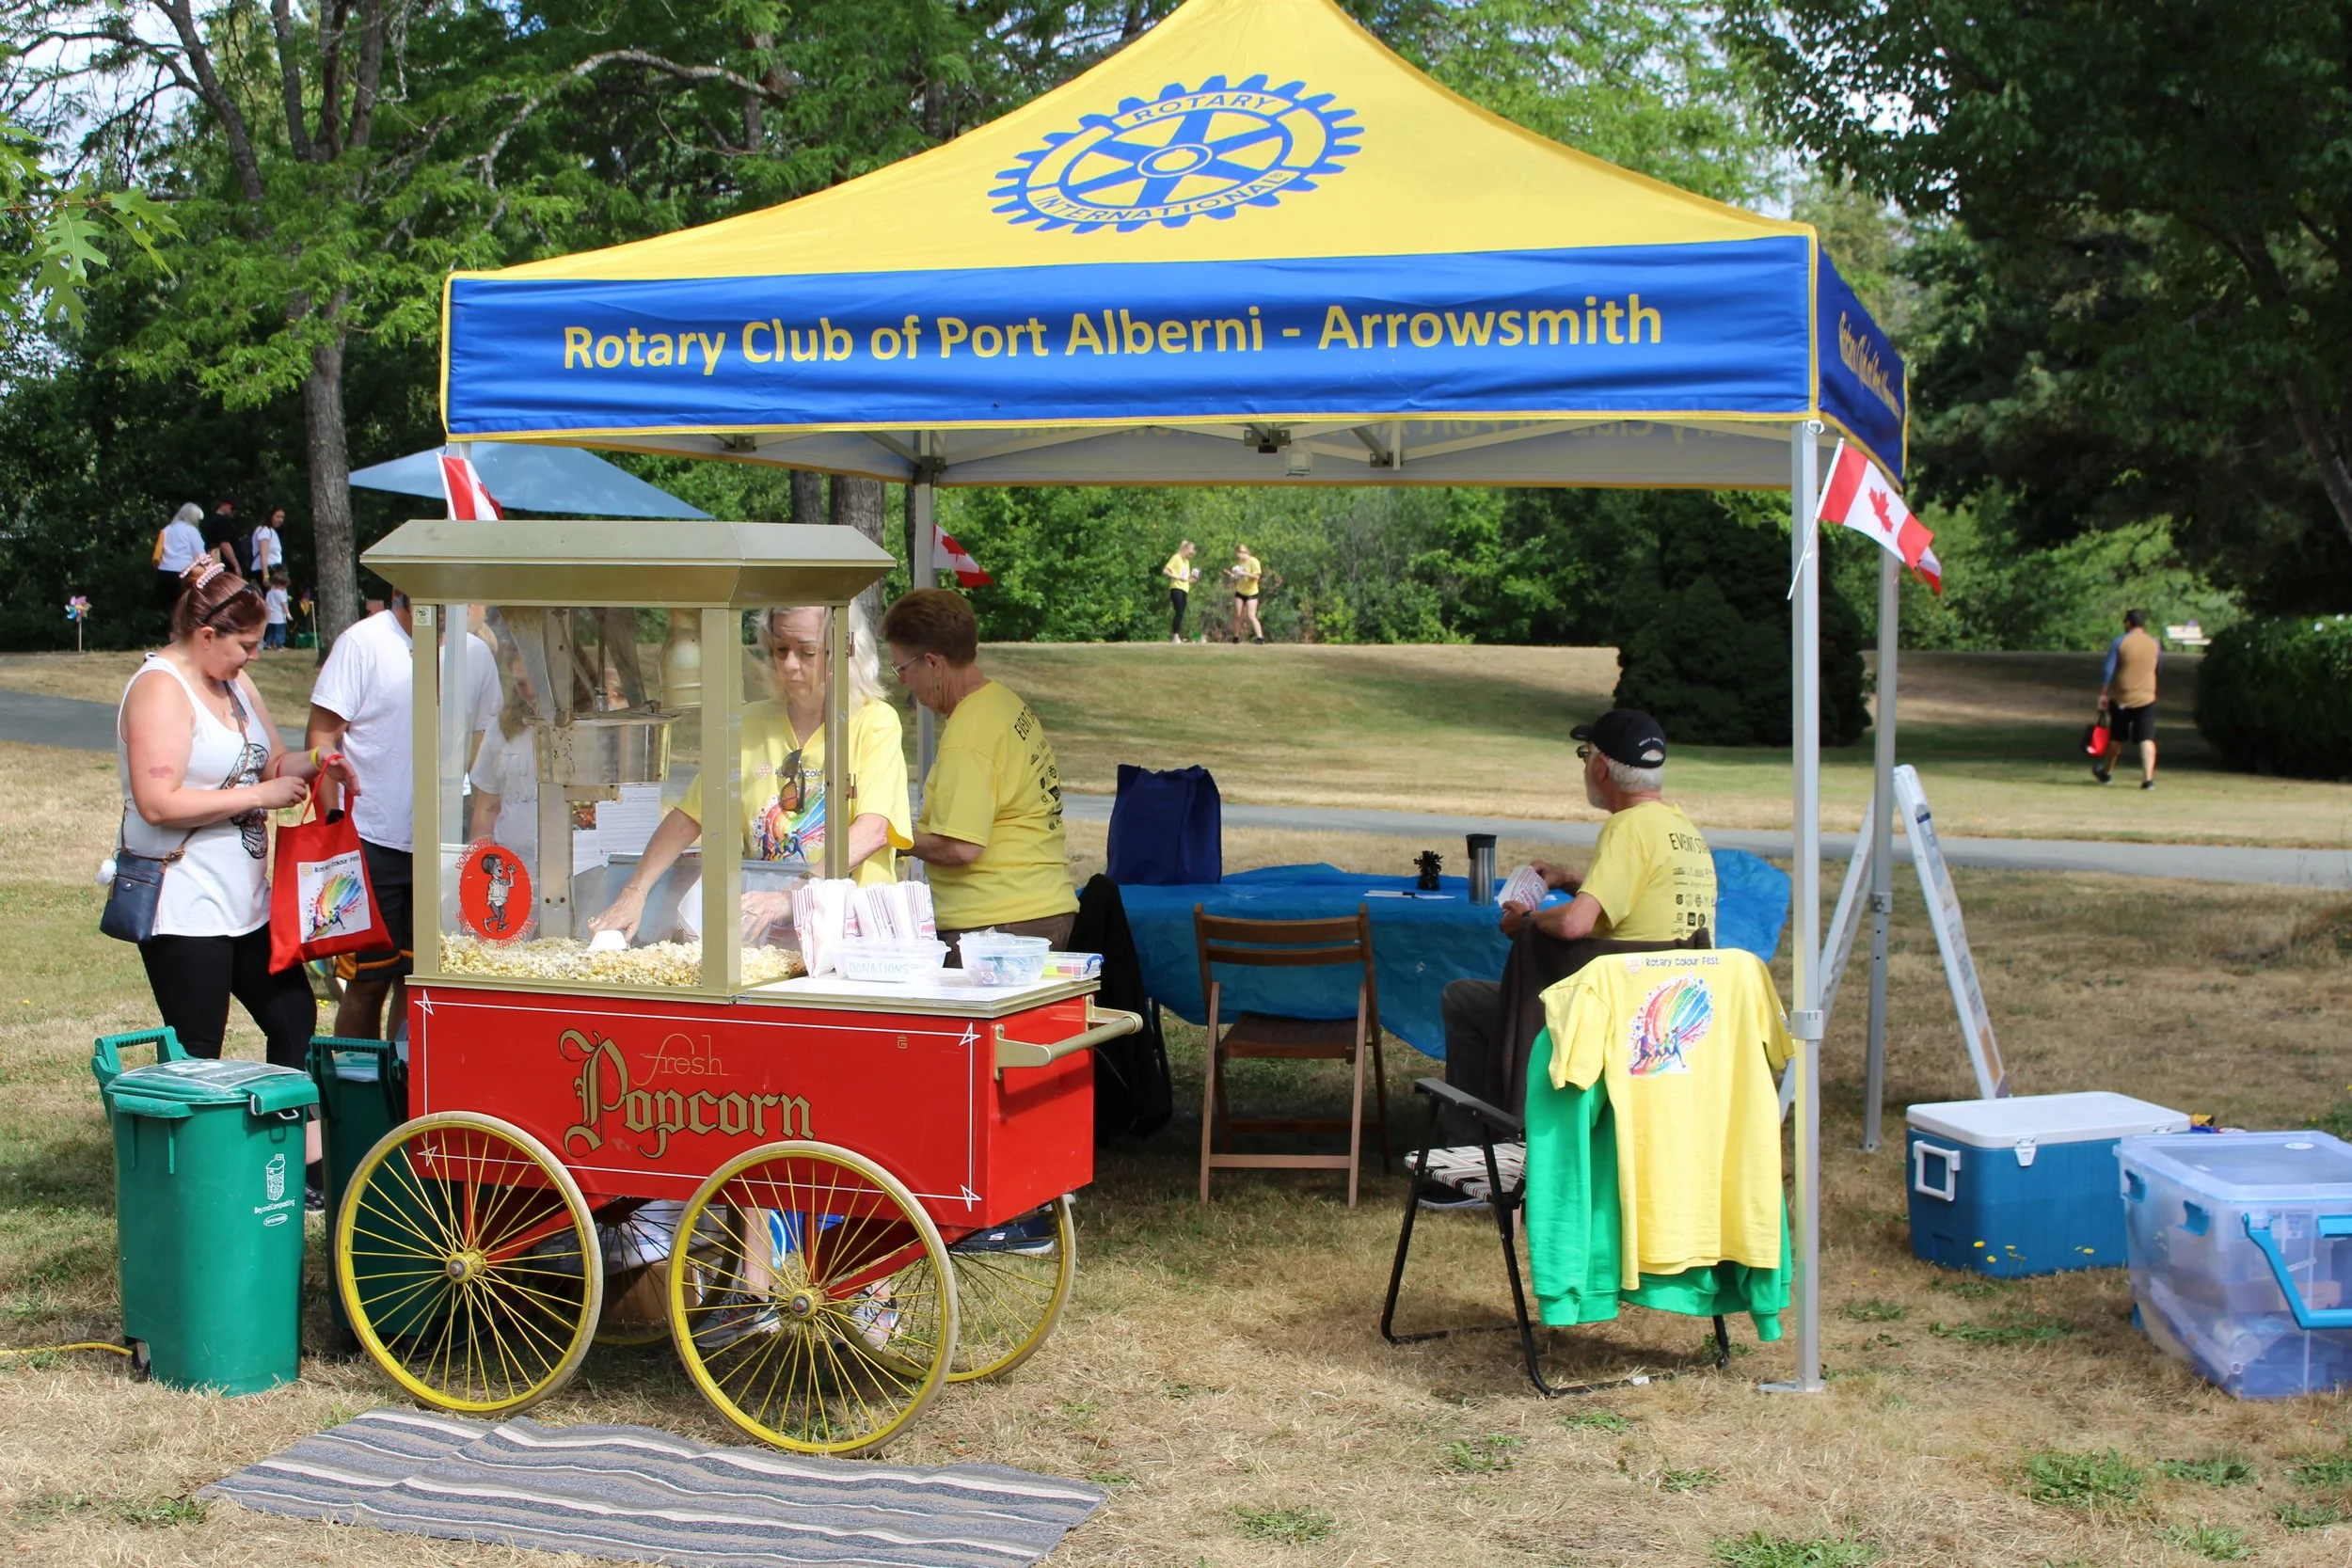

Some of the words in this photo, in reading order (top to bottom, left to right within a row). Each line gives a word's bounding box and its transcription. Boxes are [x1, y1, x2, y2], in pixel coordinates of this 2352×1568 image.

[1133, 94, 1277, 122] ROTARY
[564, 326, 726, 376] Rotary
[741, 317, 854, 364] Club
[870, 314, 922, 360] of
[936, 316, 1049, 359] Port
[1064, 305, 1264, 356] Alberni
[1282, 327, 1301, 338] -
[1317, 293, 1662, 350] Arrowsmith
[455, 837, 494, 871] POPCORN
[1669, 832, 1696, 853] EVENT
[849, 961, 910, 974] DONATIONS
[1645, 957, 1672, 968] Rotary
[1675, 957, 1699, 967] Colour
[1702, 956, 1720, 965] Fest
[632, 1033, 728, 1086] fresh
[558, 1028, 817, 1159] Popcorn
